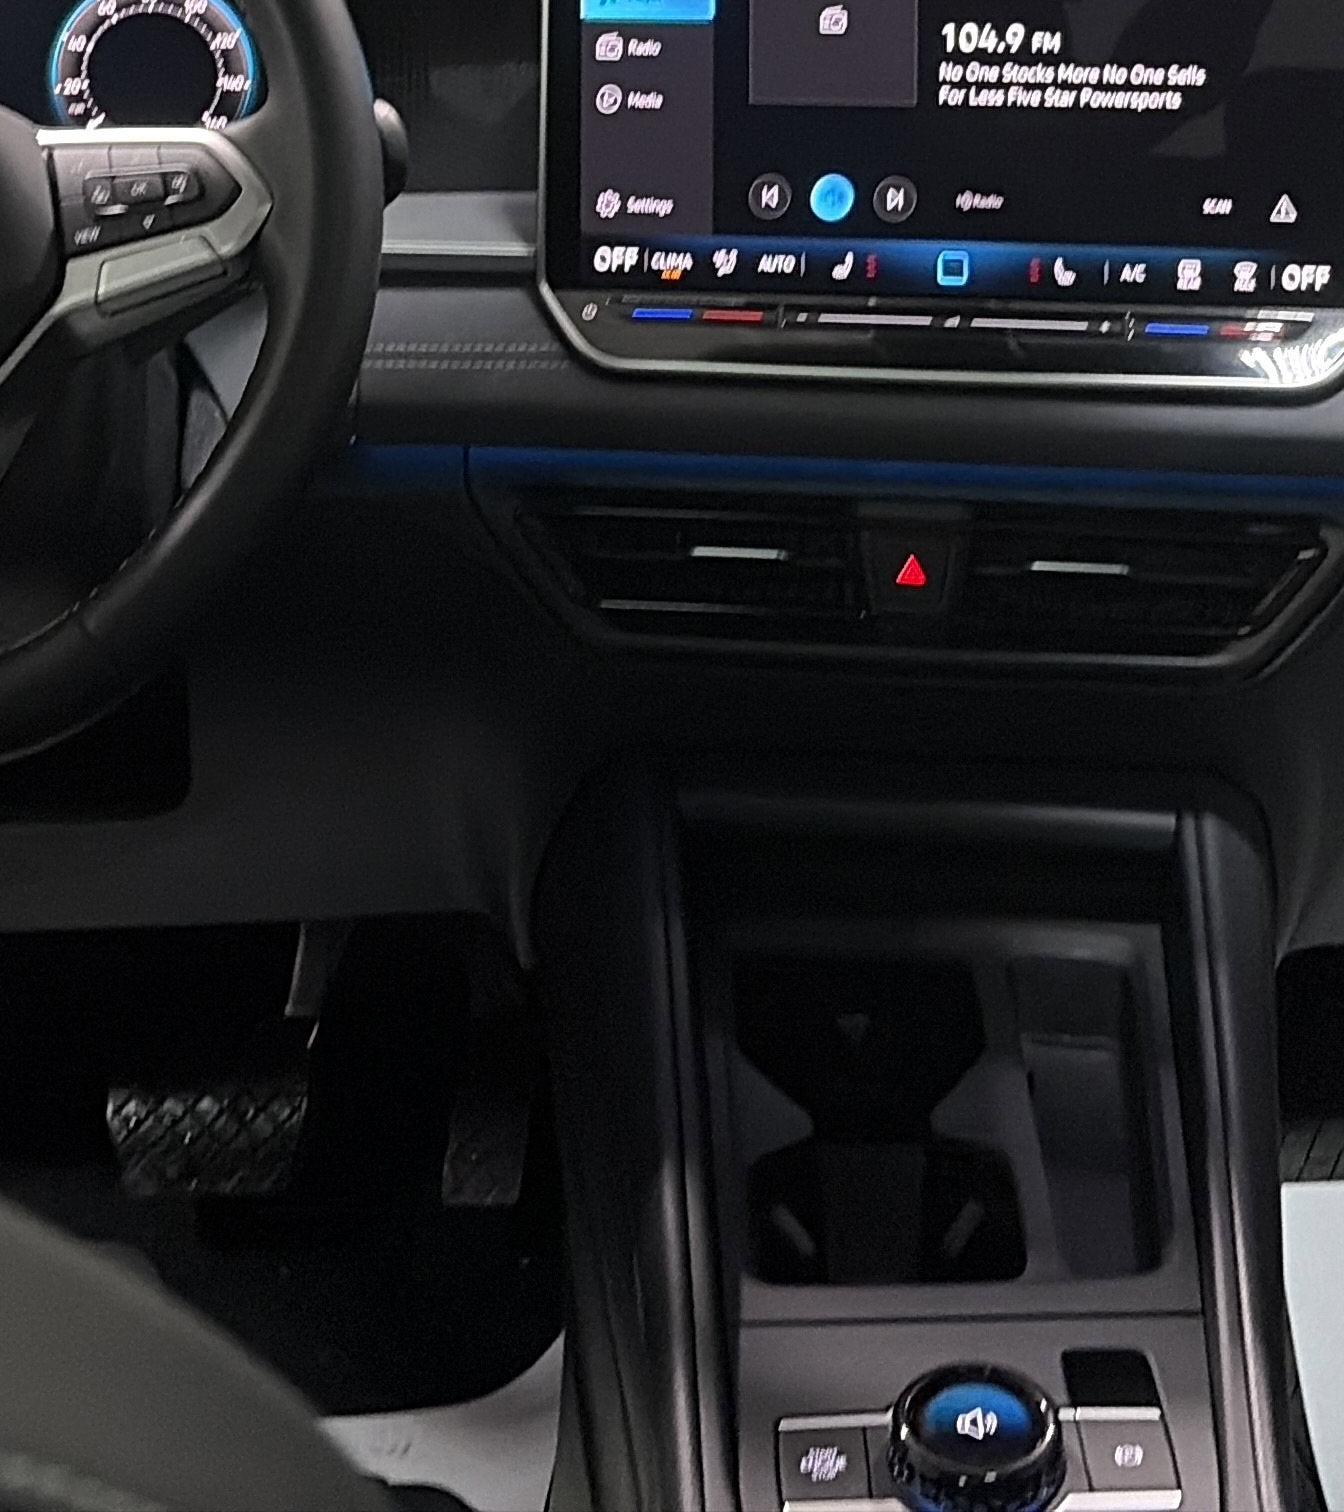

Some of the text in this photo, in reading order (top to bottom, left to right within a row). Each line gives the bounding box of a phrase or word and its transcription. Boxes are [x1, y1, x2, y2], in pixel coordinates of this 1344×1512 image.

[627, 38, 662, 57] Radio
[941, 22, 1062, 55] 104.9 FM
[938, 61, 963, 83] No
[965, 61, 1000, 84] One
[1001, 62, 1055, 85] Stocks
[1057, 63, 1099, 85] More
[1102, 63, 1128, 86] No
[1130, 64, 1166, 86] One
[627, 92, 665, 110] Media
[938, 84, 1183, 113] For Less Five Star Powersports
[626, 195, 675, 218] Settings
[593, 246, 640, 273] OFF
[758, 254, 797, 274] AUTO
[1281, 263, 1332, 292] OFF
